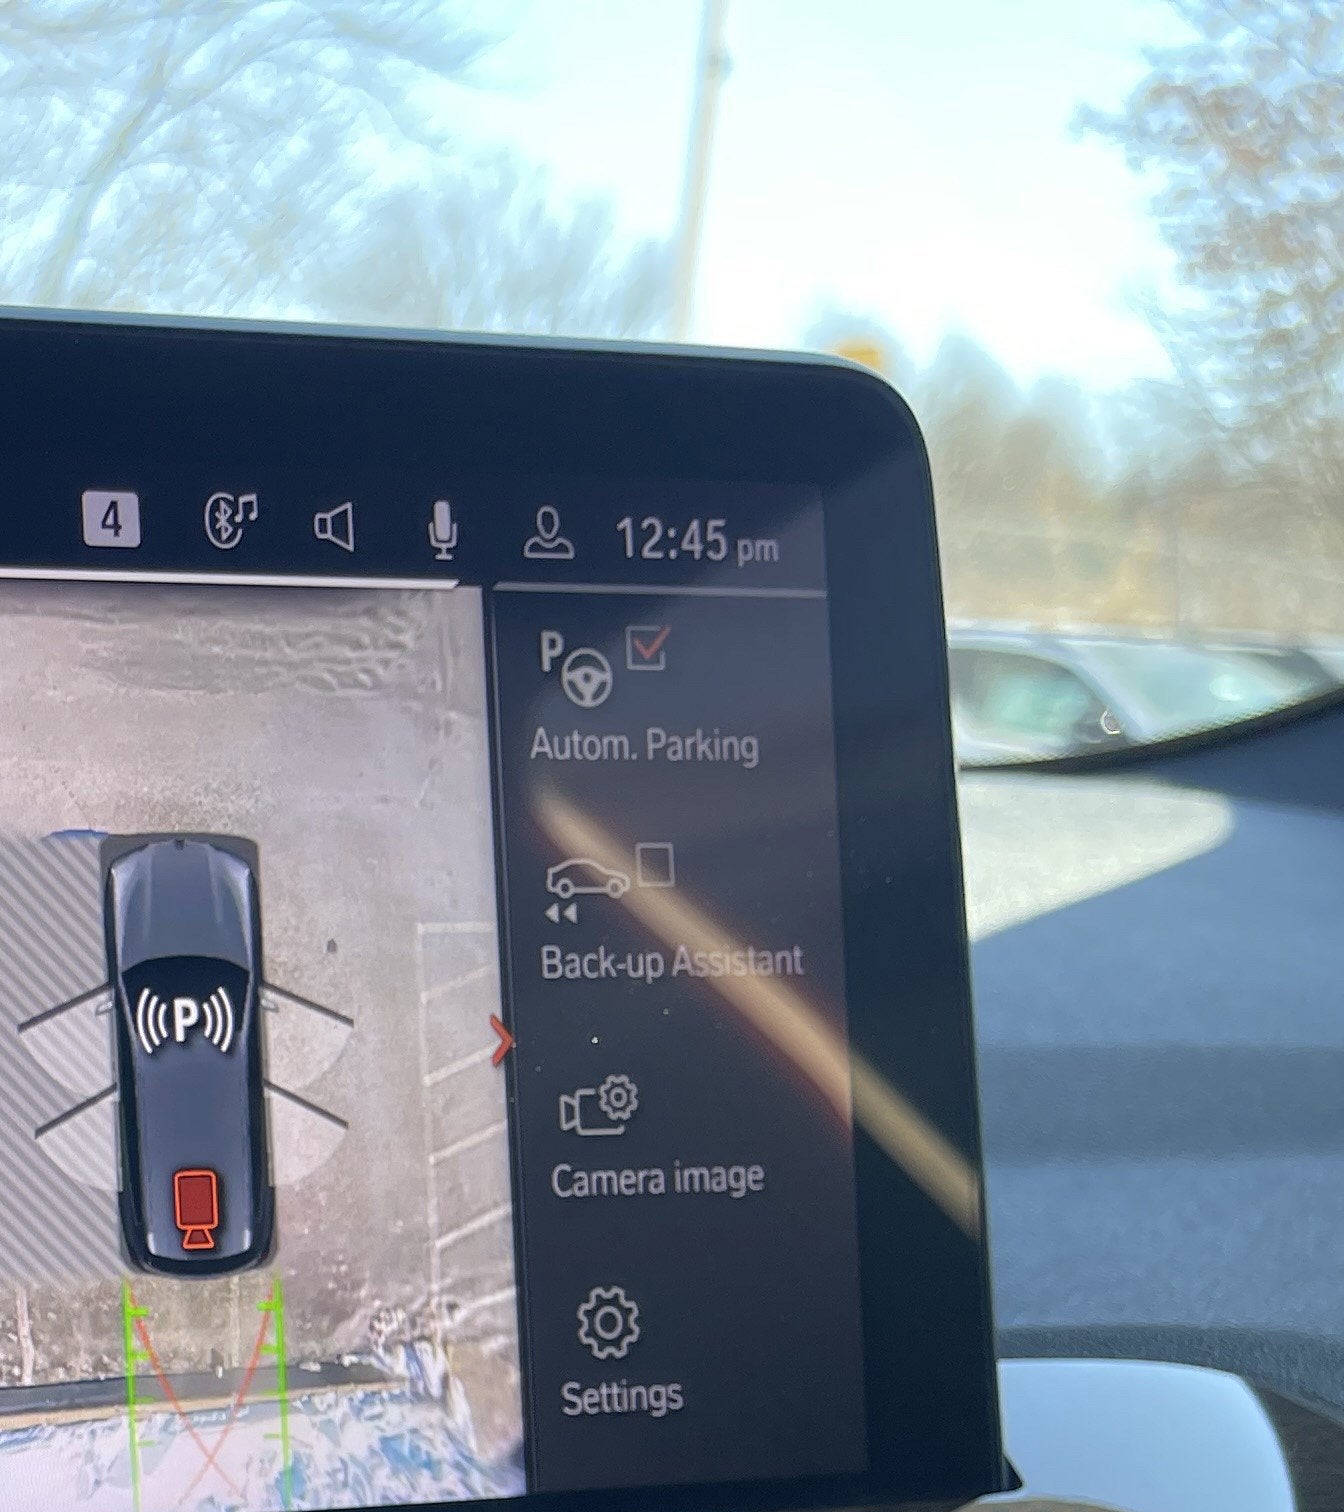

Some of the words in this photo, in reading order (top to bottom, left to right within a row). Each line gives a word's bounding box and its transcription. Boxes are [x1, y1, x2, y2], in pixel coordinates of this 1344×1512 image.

[99, 501, 122, 537] 4
[615, 515, 729, 564] 12:45
[736, 533, 781, 568] pm
[530, 726, 640, 763] Autom.
[646, 727, 761, 768] Parking
[539, 944, 666, 984] Back-up
[671, 944, 805, 978] Assistant
[550, 1162, 667, 1199] Camera
[672, 1159, 766, 1199] image
[559, 1379, 685, 1419] Settings
